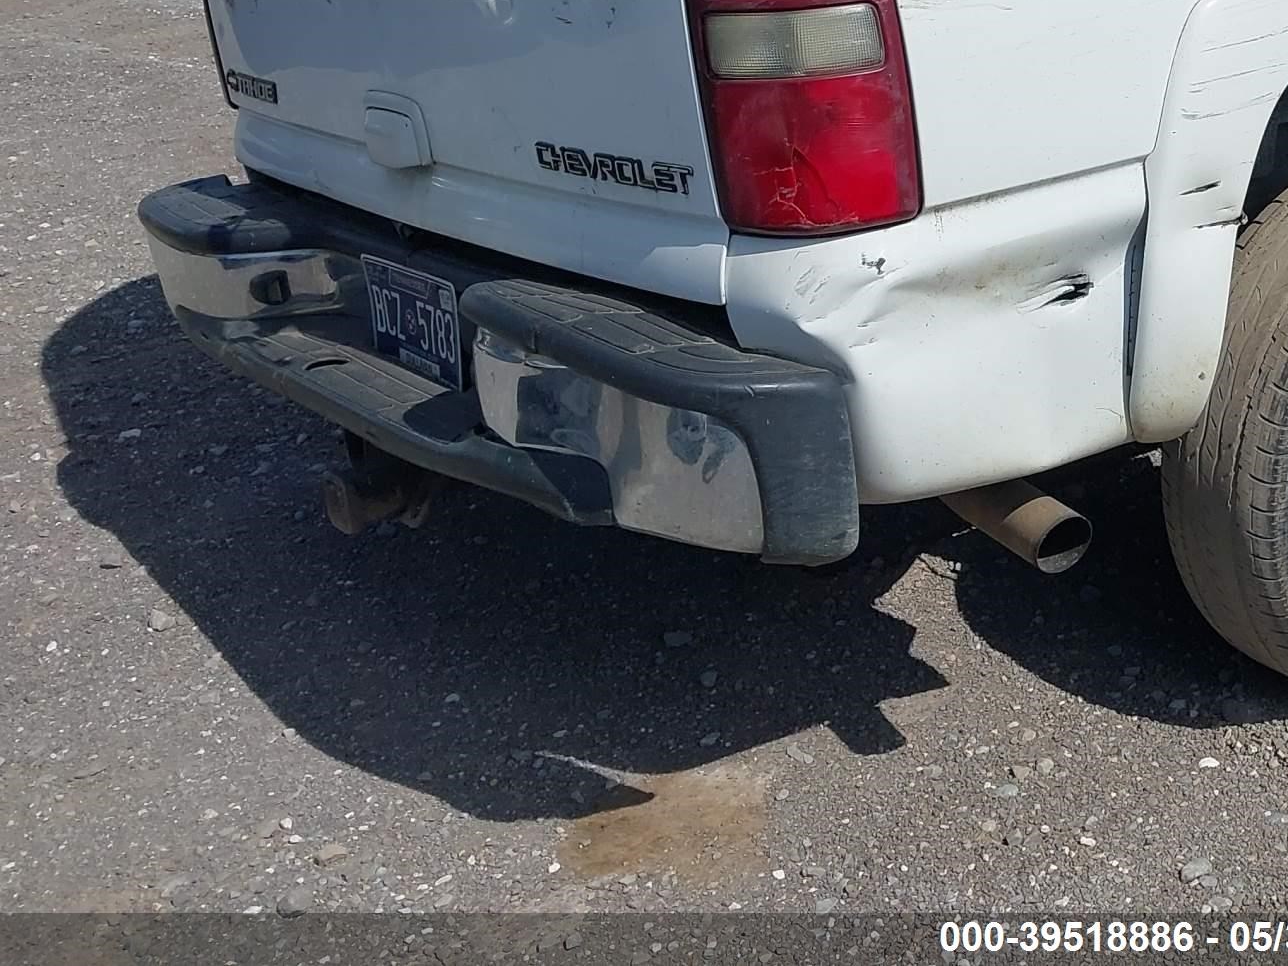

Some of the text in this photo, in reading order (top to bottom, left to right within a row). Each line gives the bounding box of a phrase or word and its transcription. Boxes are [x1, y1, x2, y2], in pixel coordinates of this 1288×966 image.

[535, 141, 694, 196] CHEVROLET
[372, 284, 406, 341] BCZ
[416, 300, 456, 364] 5783
